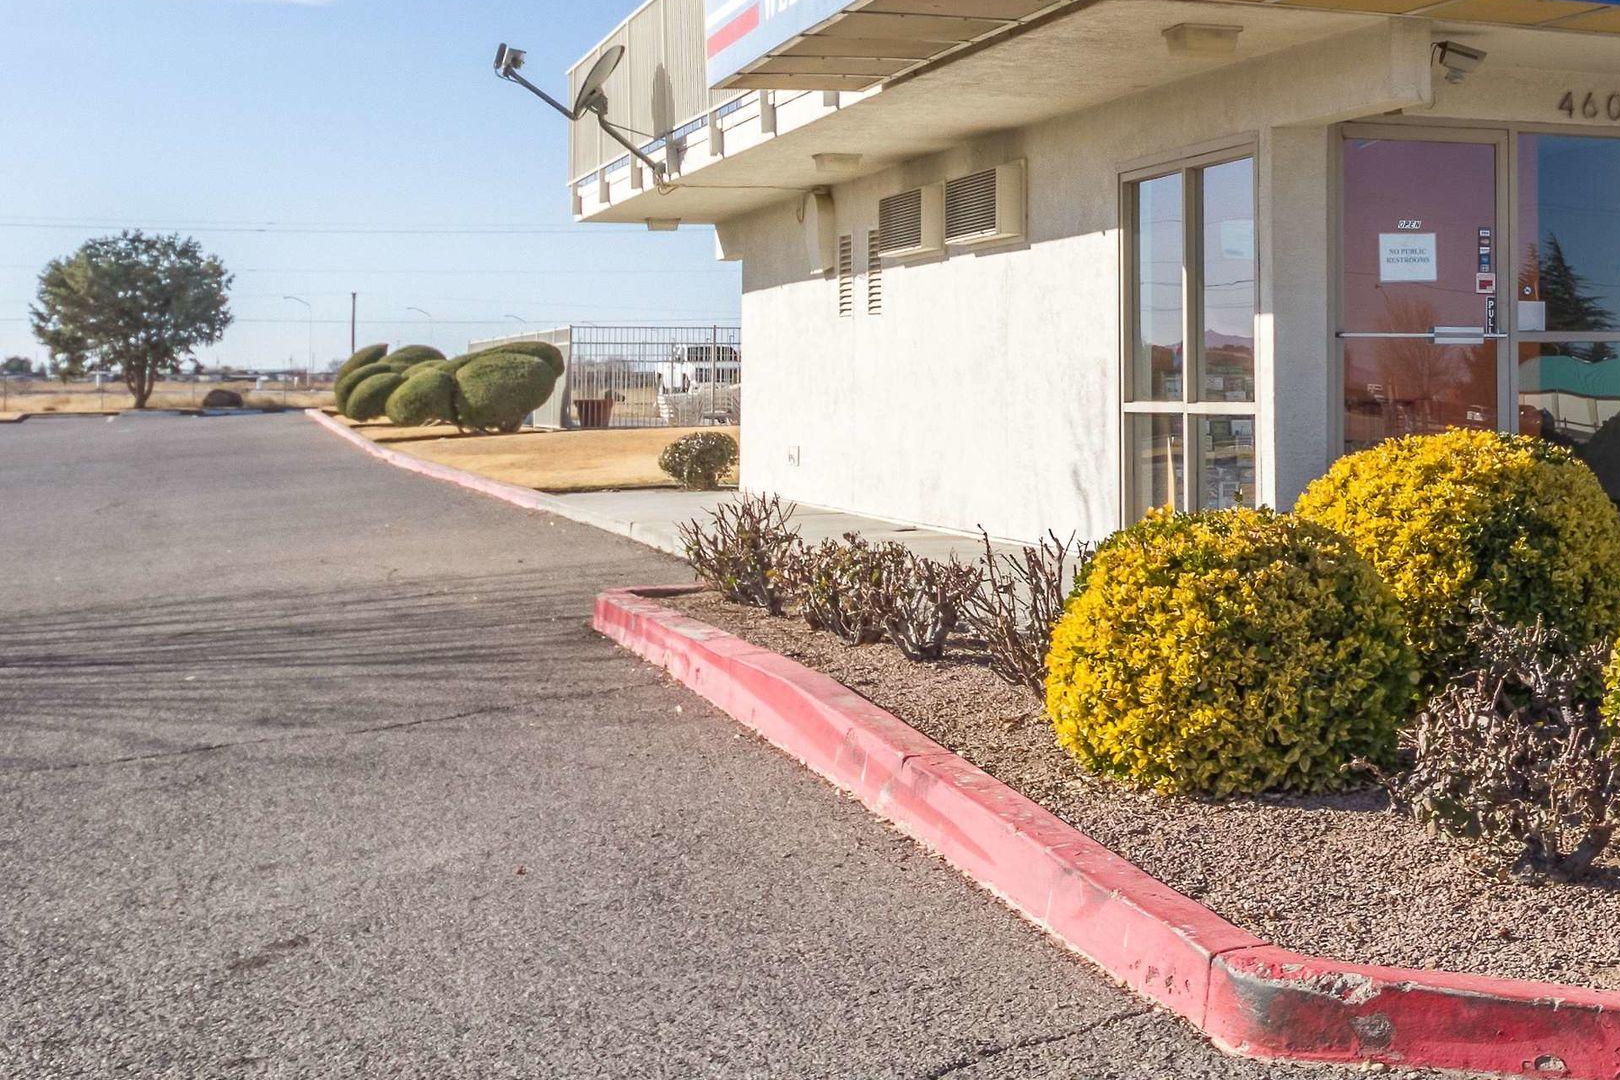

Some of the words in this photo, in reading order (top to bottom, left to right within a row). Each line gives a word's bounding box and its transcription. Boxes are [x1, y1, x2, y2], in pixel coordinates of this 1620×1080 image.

[1397, 219, 1422, 229] OPEN
[1388, 248, 1399, 256] NO
[1400, 248, 1427, 256] PUBLIC
[1386, 256, 1431, 264] RESTROOMS
